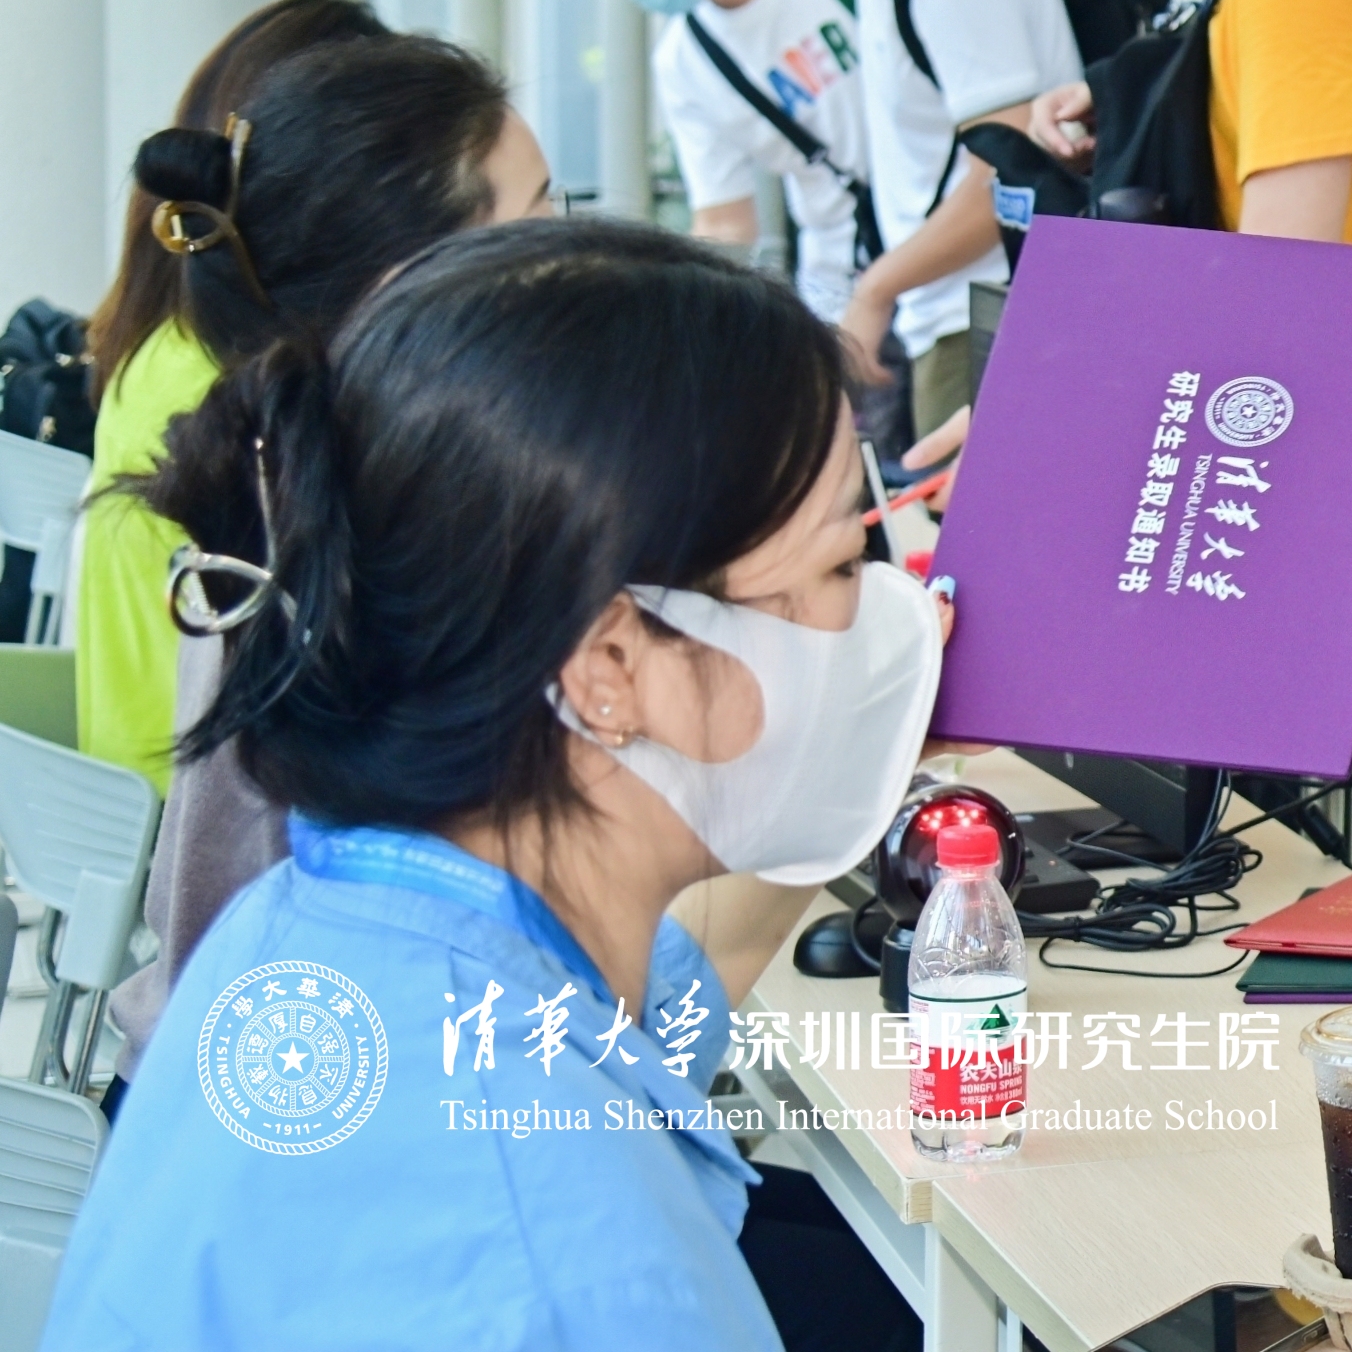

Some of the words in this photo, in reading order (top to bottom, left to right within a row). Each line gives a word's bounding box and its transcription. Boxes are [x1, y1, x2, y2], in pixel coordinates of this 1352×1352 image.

[1117, 370, 1200, 593] 研究生录取通知书
[1183, 453, 1213, 520] TSINGHUA
[1164, 521, 1196, 595] UNIVERSITY
[960, 1081, 997, 1095] NONGFU
[999, 1075, 1023, 1090] SPRING
